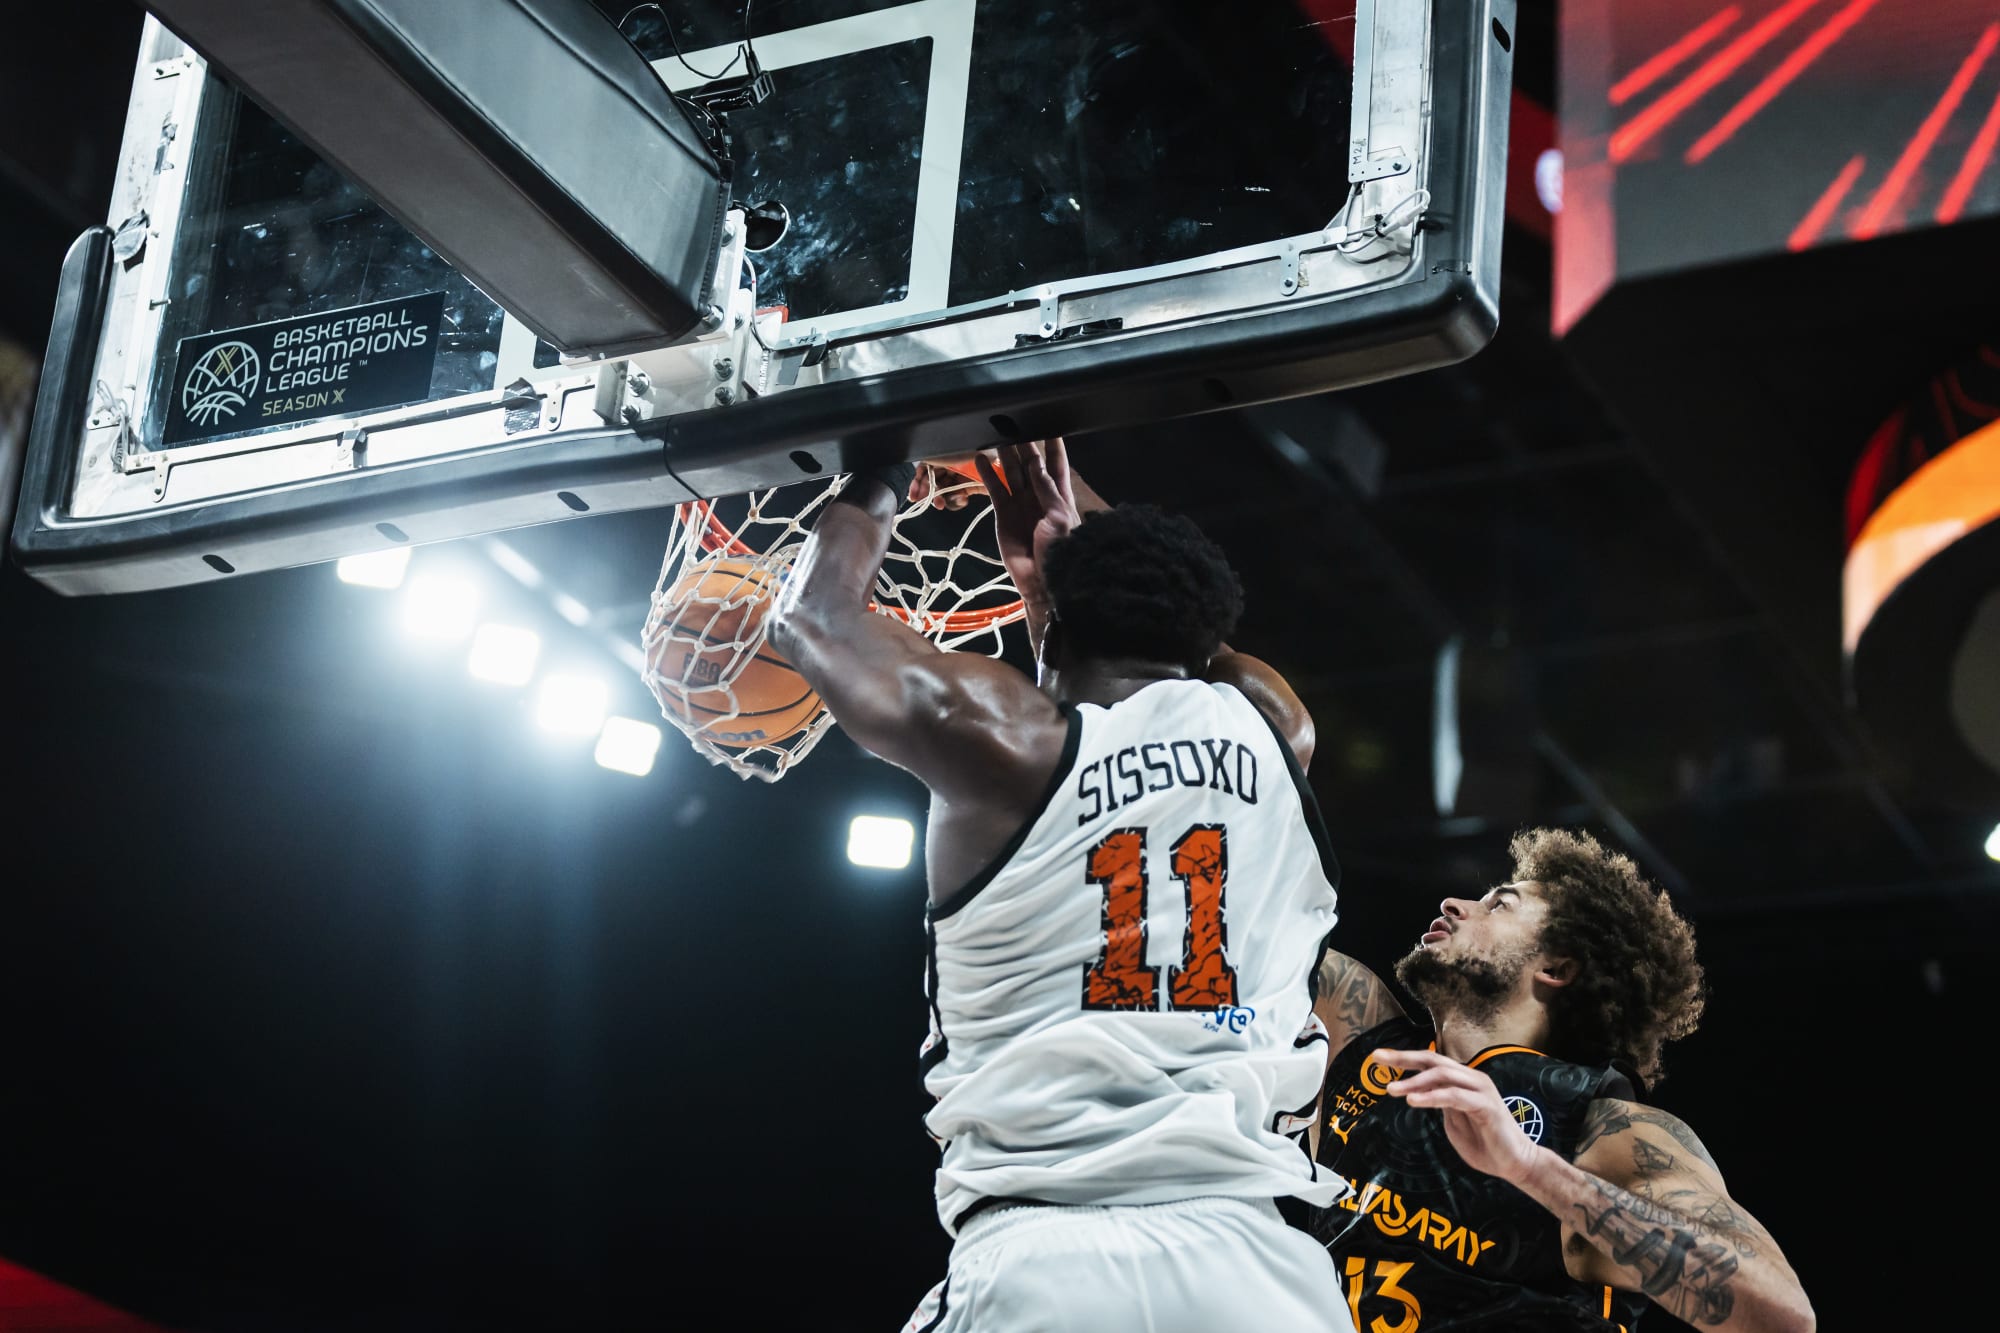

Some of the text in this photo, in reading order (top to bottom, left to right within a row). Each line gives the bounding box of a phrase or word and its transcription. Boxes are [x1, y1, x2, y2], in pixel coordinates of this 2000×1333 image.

[269, 325, 429, 372] CHAMPIONS
[273, 309, 412, 348] BASKETBALL
[265, 362, 351, 393] LEAGUE
[261, 388, 346, 417] SEASON X
[1078, 738, 1258, 826] SISSOKO
[1081, 823, 1240, 1012] 11
[1345, 1084, 1378, 1108] MCT
[1345, 1256, 1422, 1333] 13
